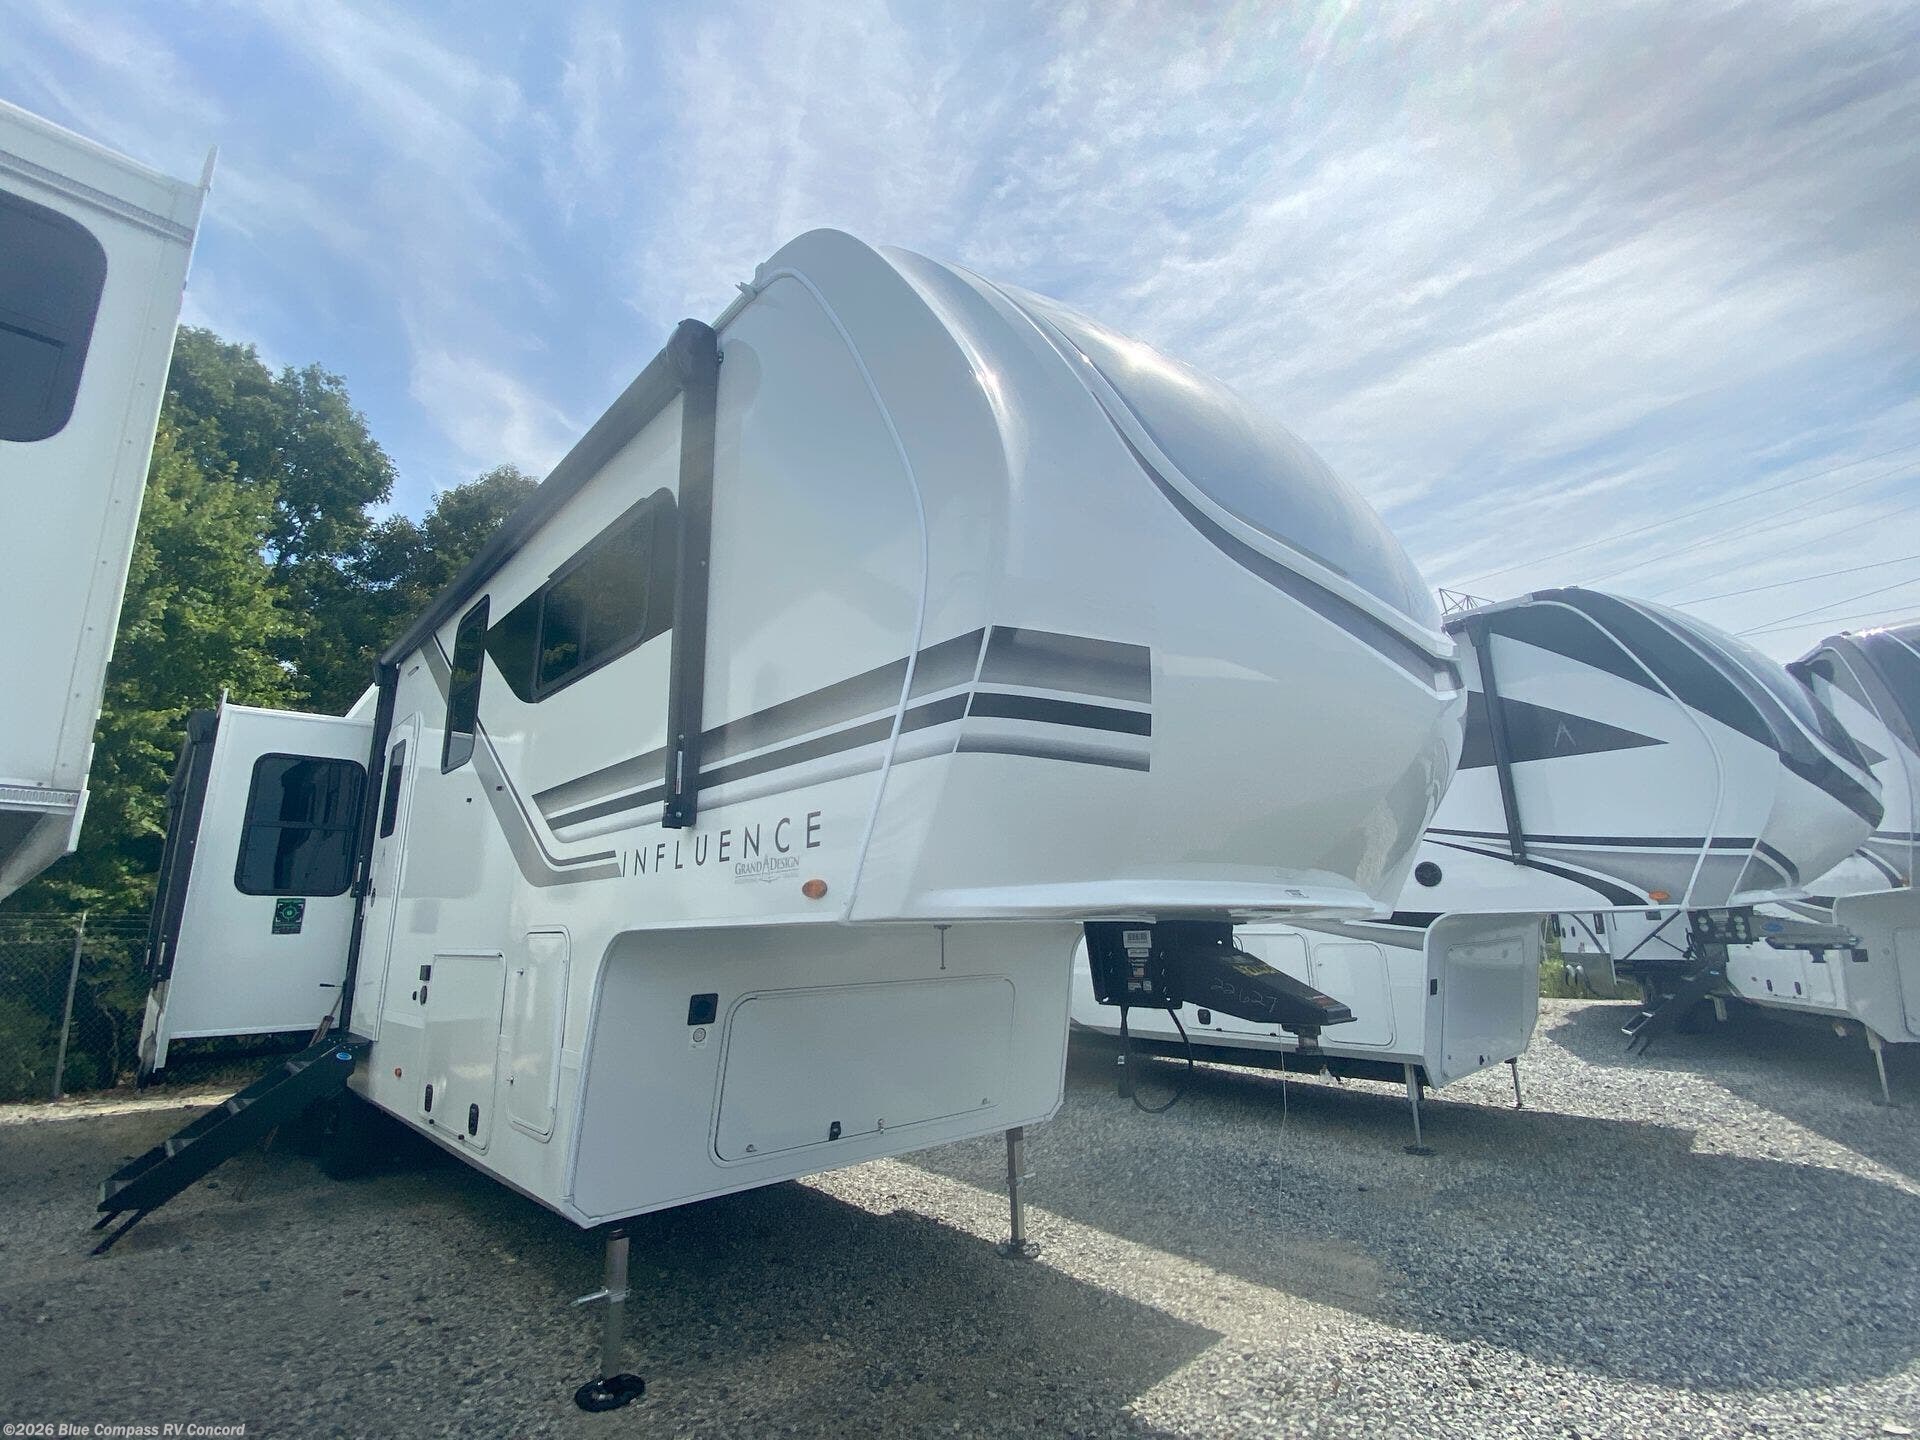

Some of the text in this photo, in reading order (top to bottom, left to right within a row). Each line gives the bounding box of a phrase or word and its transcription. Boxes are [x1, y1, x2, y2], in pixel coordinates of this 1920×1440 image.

[622, 811, 821, 877] INFLUENCE
[735, 856, 799, 875] GRAND DESIGN
